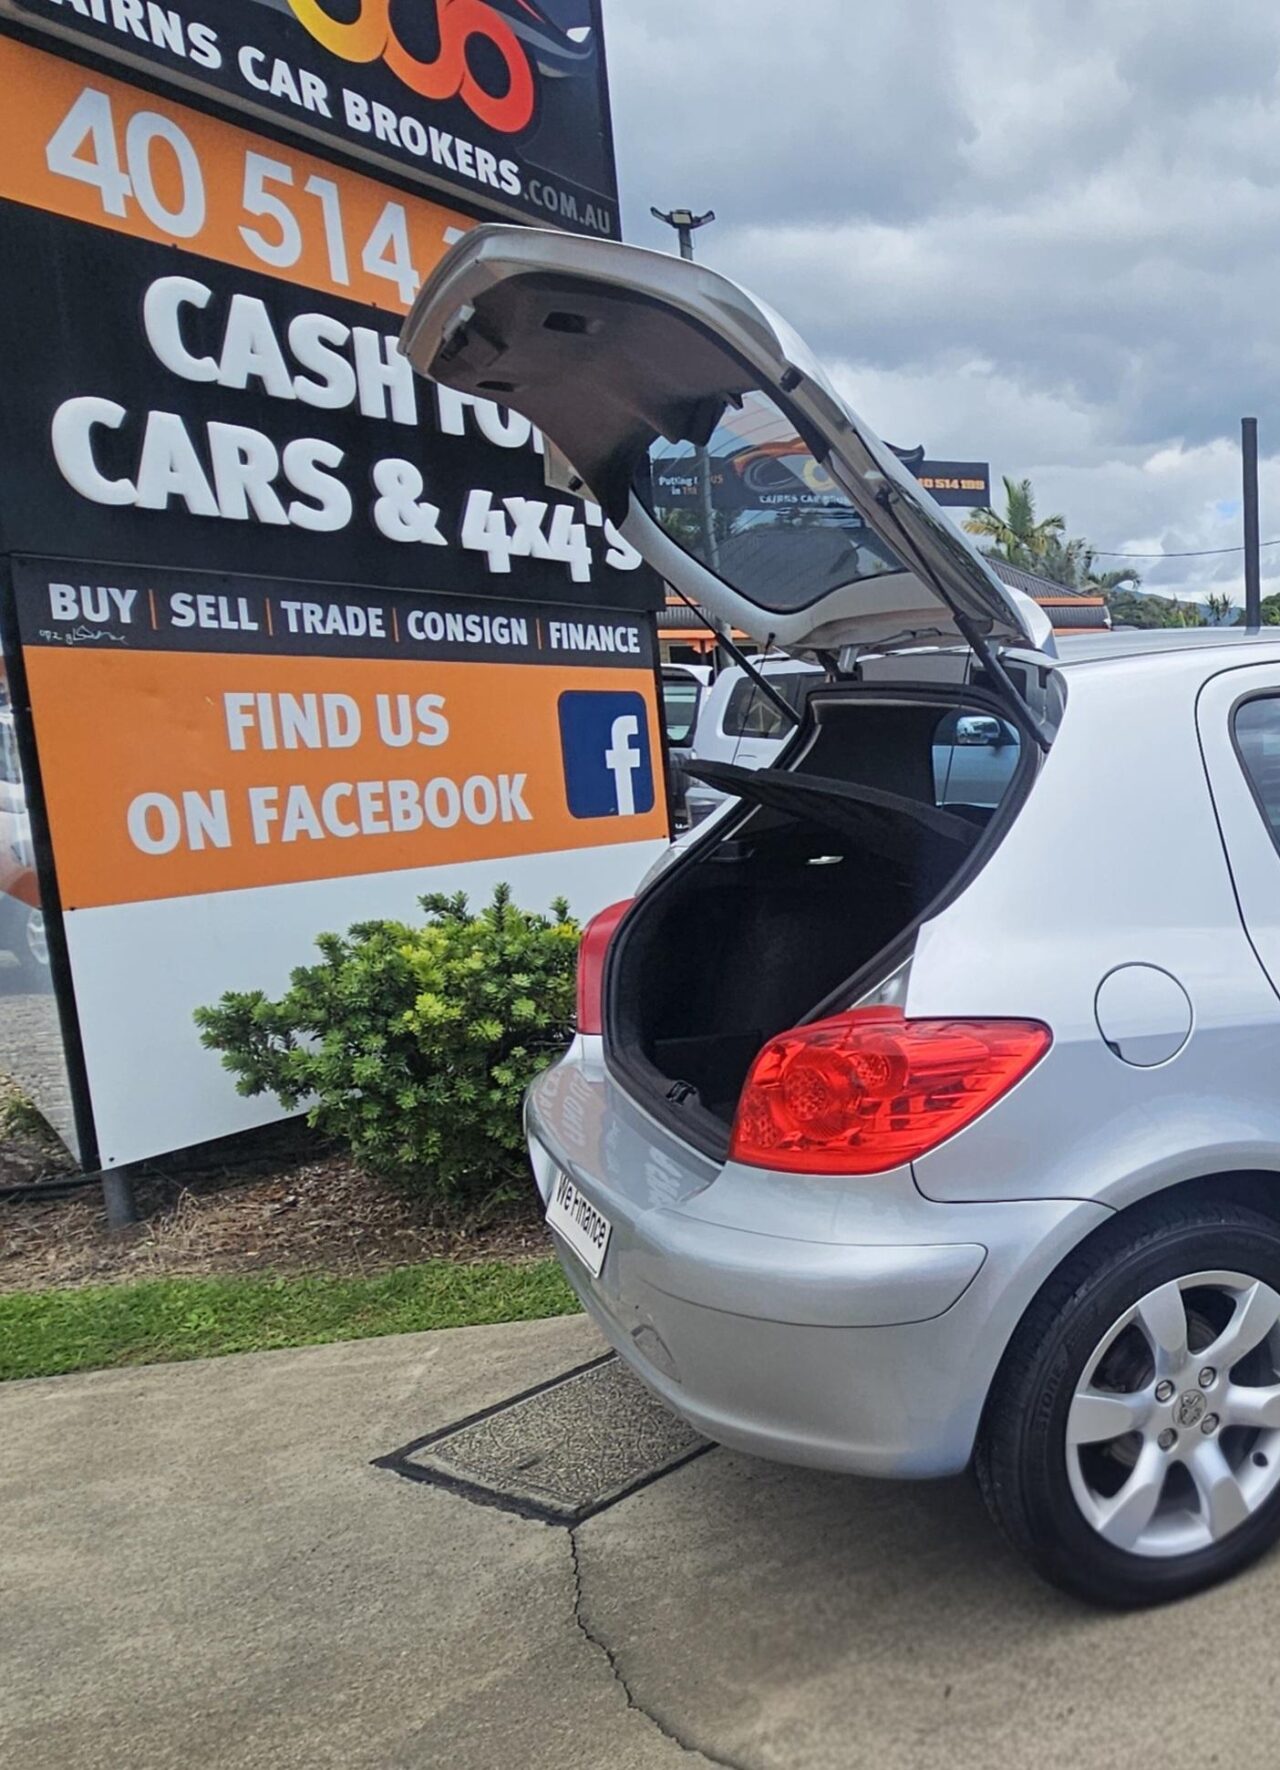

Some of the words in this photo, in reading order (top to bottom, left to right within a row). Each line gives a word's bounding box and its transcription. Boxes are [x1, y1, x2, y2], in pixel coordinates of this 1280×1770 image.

[237, 46, 332, 119] CAR
[46, 87, 206, 239] 40
[238, 150, 420, 303] 514
[144, 276, 418, 426] CASH
[51, 396, 352, 532] CARS
[372, 458, 448, 546] &
[48, 583, 137, 624] BUY
[171, 593, 258, 632] SELL
[280, 600, 386, 638] TRADE
[407, 610, 528, 646] CONSIGN
[549, 622, 640, 654] FINANCE
[224, 692, 362, 751] FIND
[377, 694, 450, 746] US
[127, 789, 232, 855] ON
[249, 773, 533, 845] FACEBOOK
